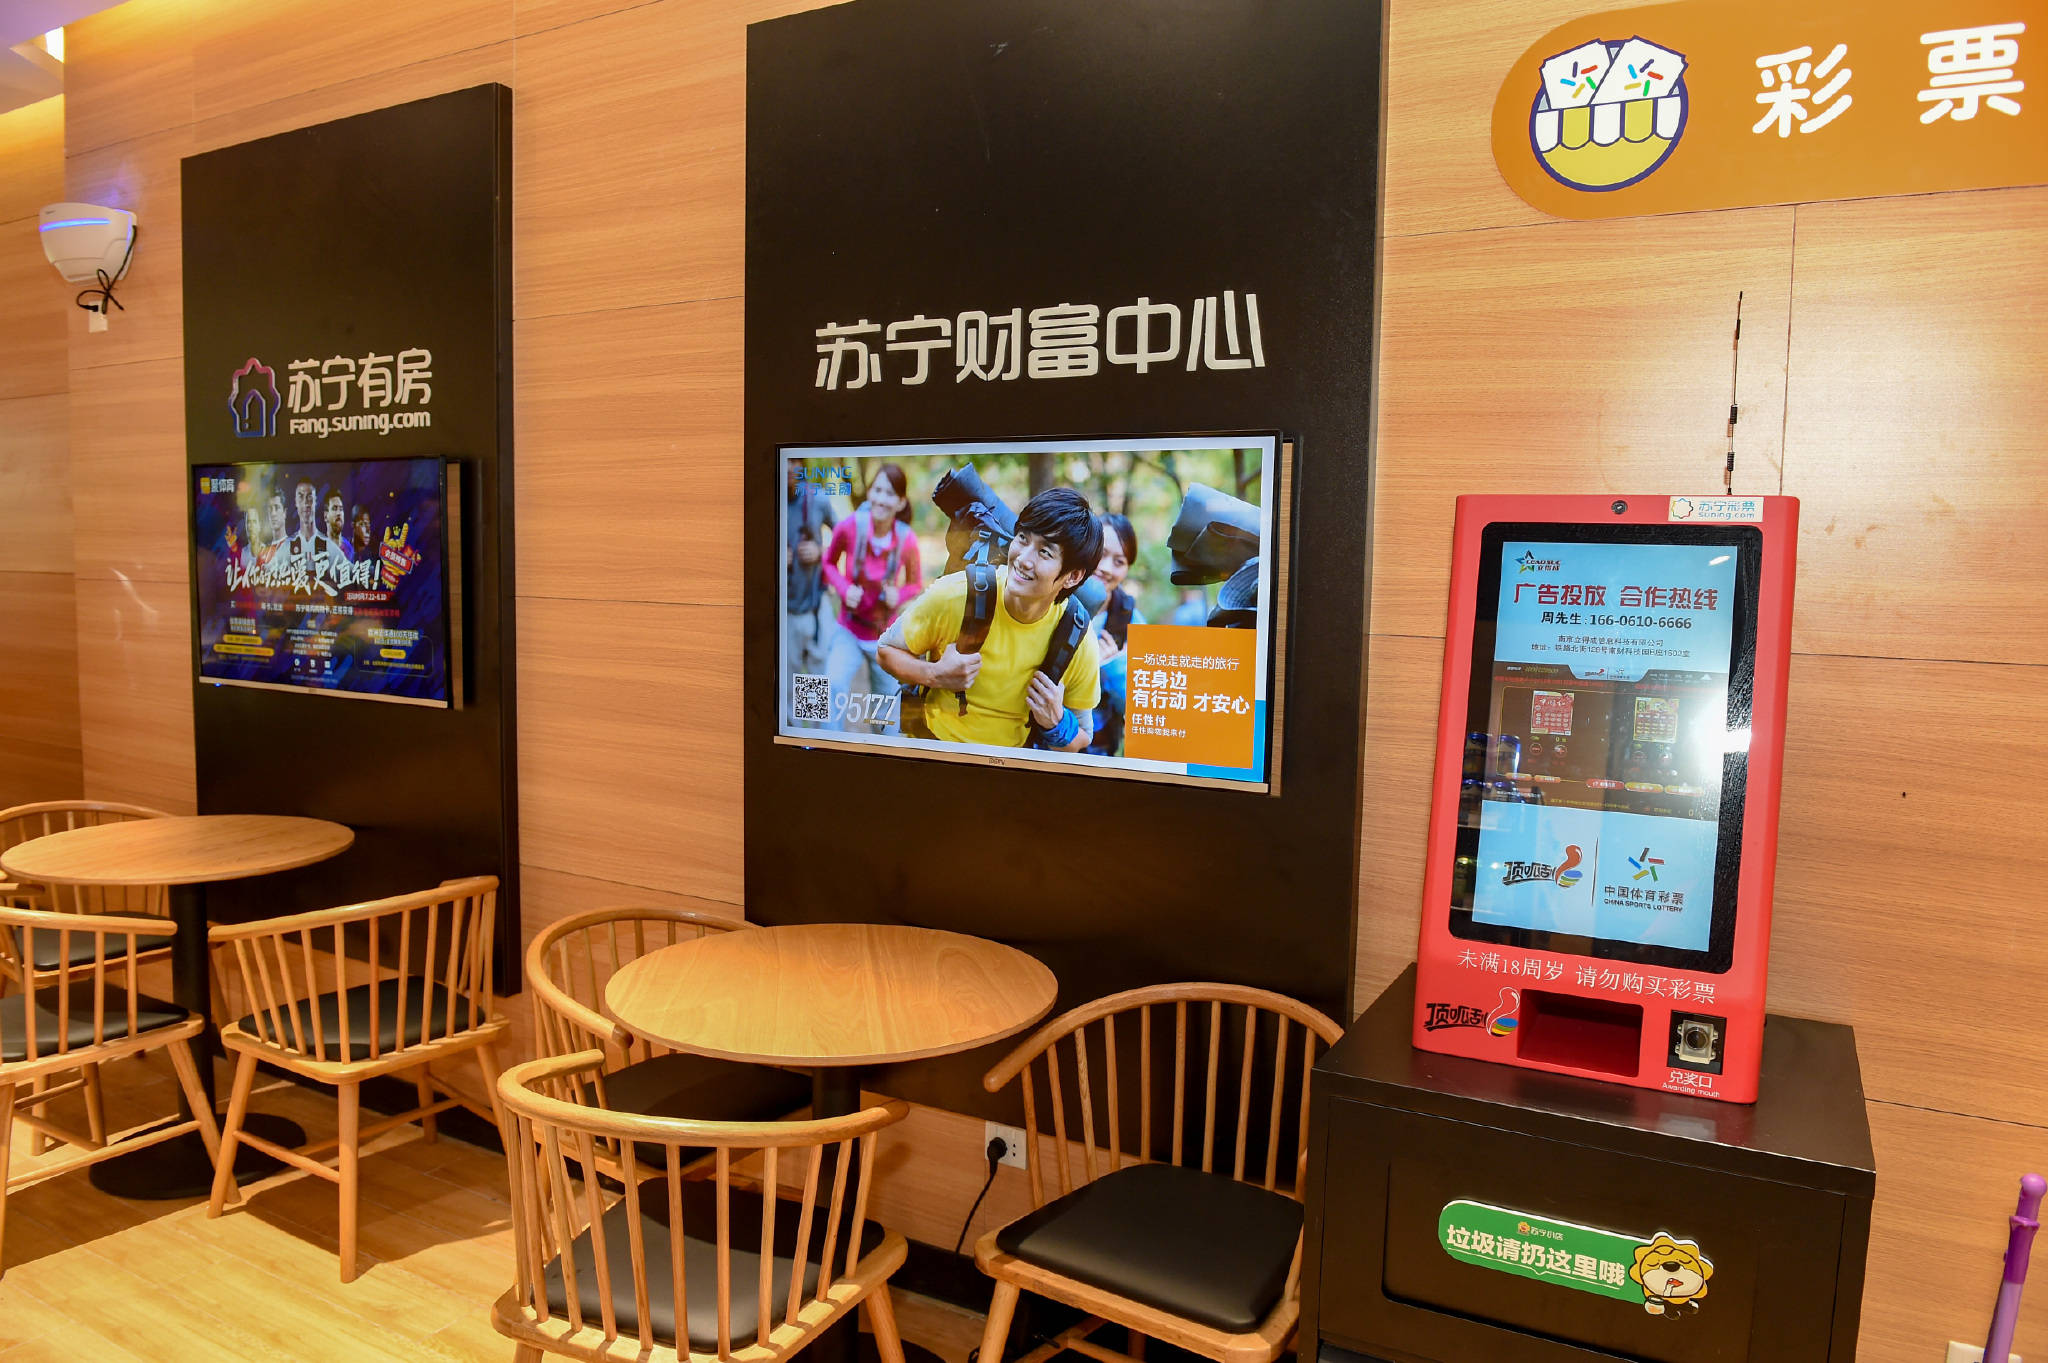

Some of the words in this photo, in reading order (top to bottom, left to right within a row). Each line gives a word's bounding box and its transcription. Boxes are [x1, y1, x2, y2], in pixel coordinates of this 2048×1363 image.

[1752, 22, 2026, 138] 彩票
[815, 290, 1265, 390] 苏宁财富中心
[287, 347, 432, 413] 苏宁有房
[290, 411, 431, 438] Fang.suning.com
[793, 466, 852, 479] SUNING
[1698, 511, 1755, 520] suning.com
[1514, 583, 1607, 606] 广告投放
[1620, 586, 1718, 610] 合作热线
[1132, 653, 1240, 671] 一场说走就走的旅行
[1132, 669, 1187, 690] 在身边
[835, 692, 898, 722] 95177
[1132, 689, 1187, 710] 有行动
[1193, 693, 1250, 714] 才安心
[1132, 713, 1166, 727] 任性付
[1604, 885, 1684, 905] 中国体育彩票
[1625, 901, 1652, 909] SPORTS
[1653, 904, 1683, 912] LOTTERY
[1457, 948, 1563, 981] 未满18周岁
[1576, 964, 1715, 1004] 请勿购买彩票
[1424, 1003, 1489, 1029] 顶呱刮
[1662, 1082, 1695, 1095] Awarding
[1698, 1089, 1720, 1098] mouth
[1669, 1070, 1712, 1088] 兑奖口
[1530, 1226, 1564, 1241] 苏宁小店
[1446, 1224, 1626, 1286] 垃圾请扔这里哦
